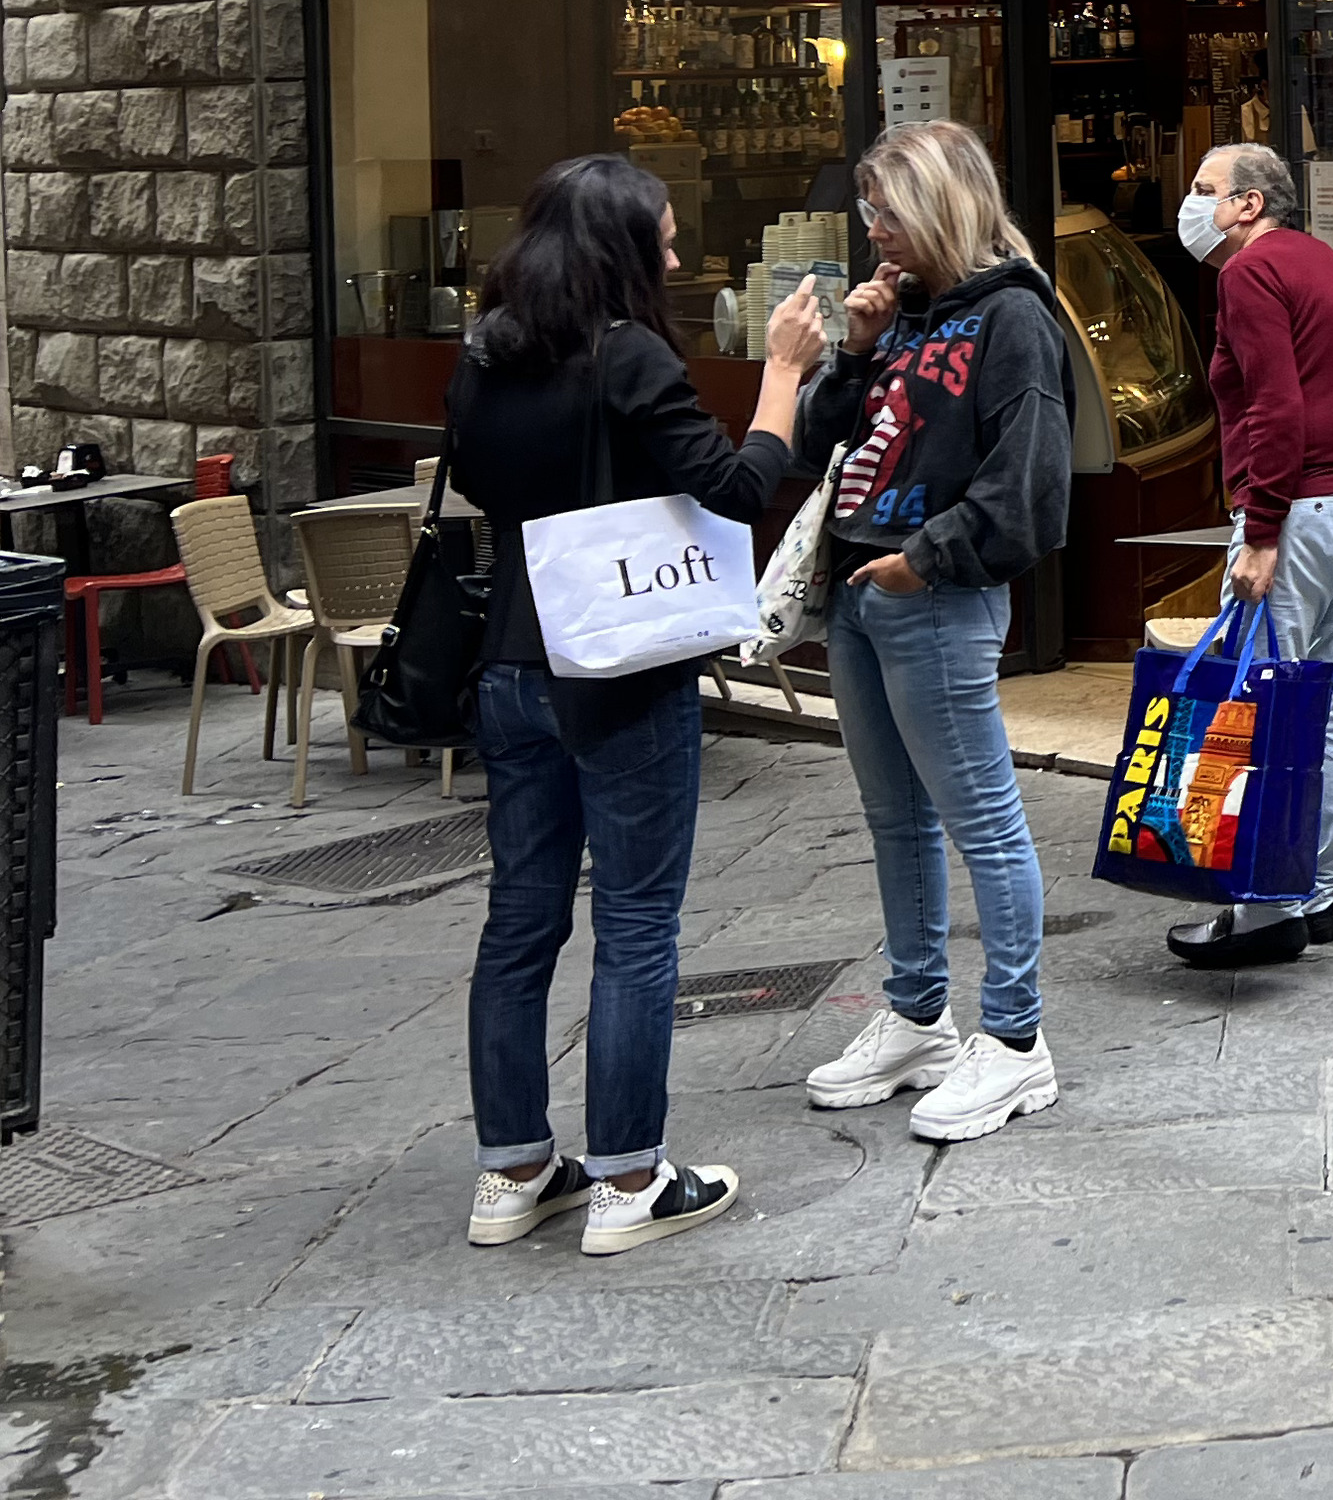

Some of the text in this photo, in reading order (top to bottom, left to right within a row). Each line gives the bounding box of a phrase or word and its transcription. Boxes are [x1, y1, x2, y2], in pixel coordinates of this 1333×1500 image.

[872, 484, 927, 525] 94
[610, 545, 720, 599] Loft
[1107, 696, 1171, 854] PARIS
